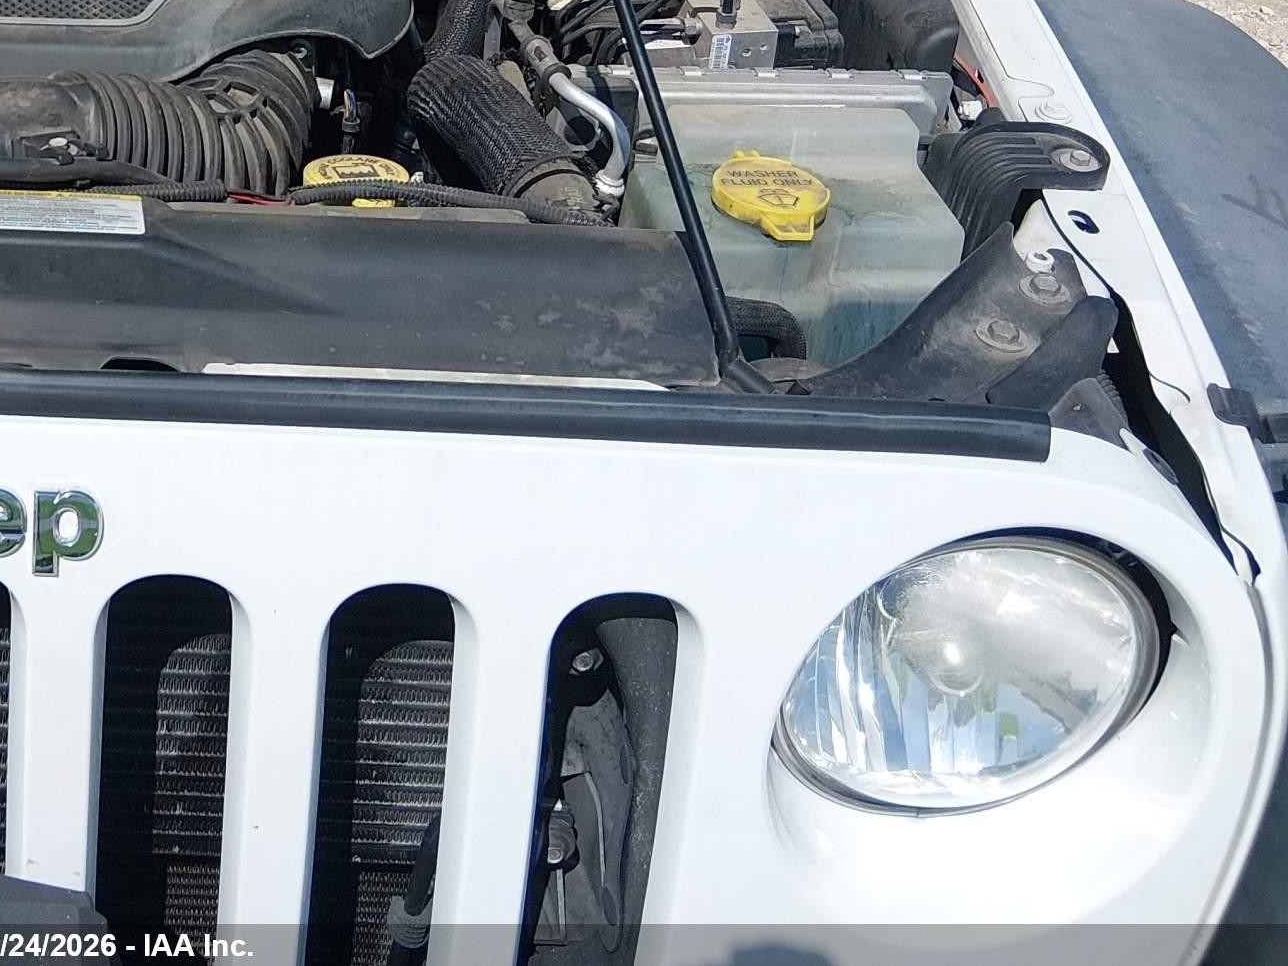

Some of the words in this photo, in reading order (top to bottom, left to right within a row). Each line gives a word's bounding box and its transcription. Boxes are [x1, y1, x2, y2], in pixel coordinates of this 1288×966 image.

[727, 169, 799, 178] WASHER
[720, 178, 768, 186] FLUID
[772, 178, 813, 186] ONLY
